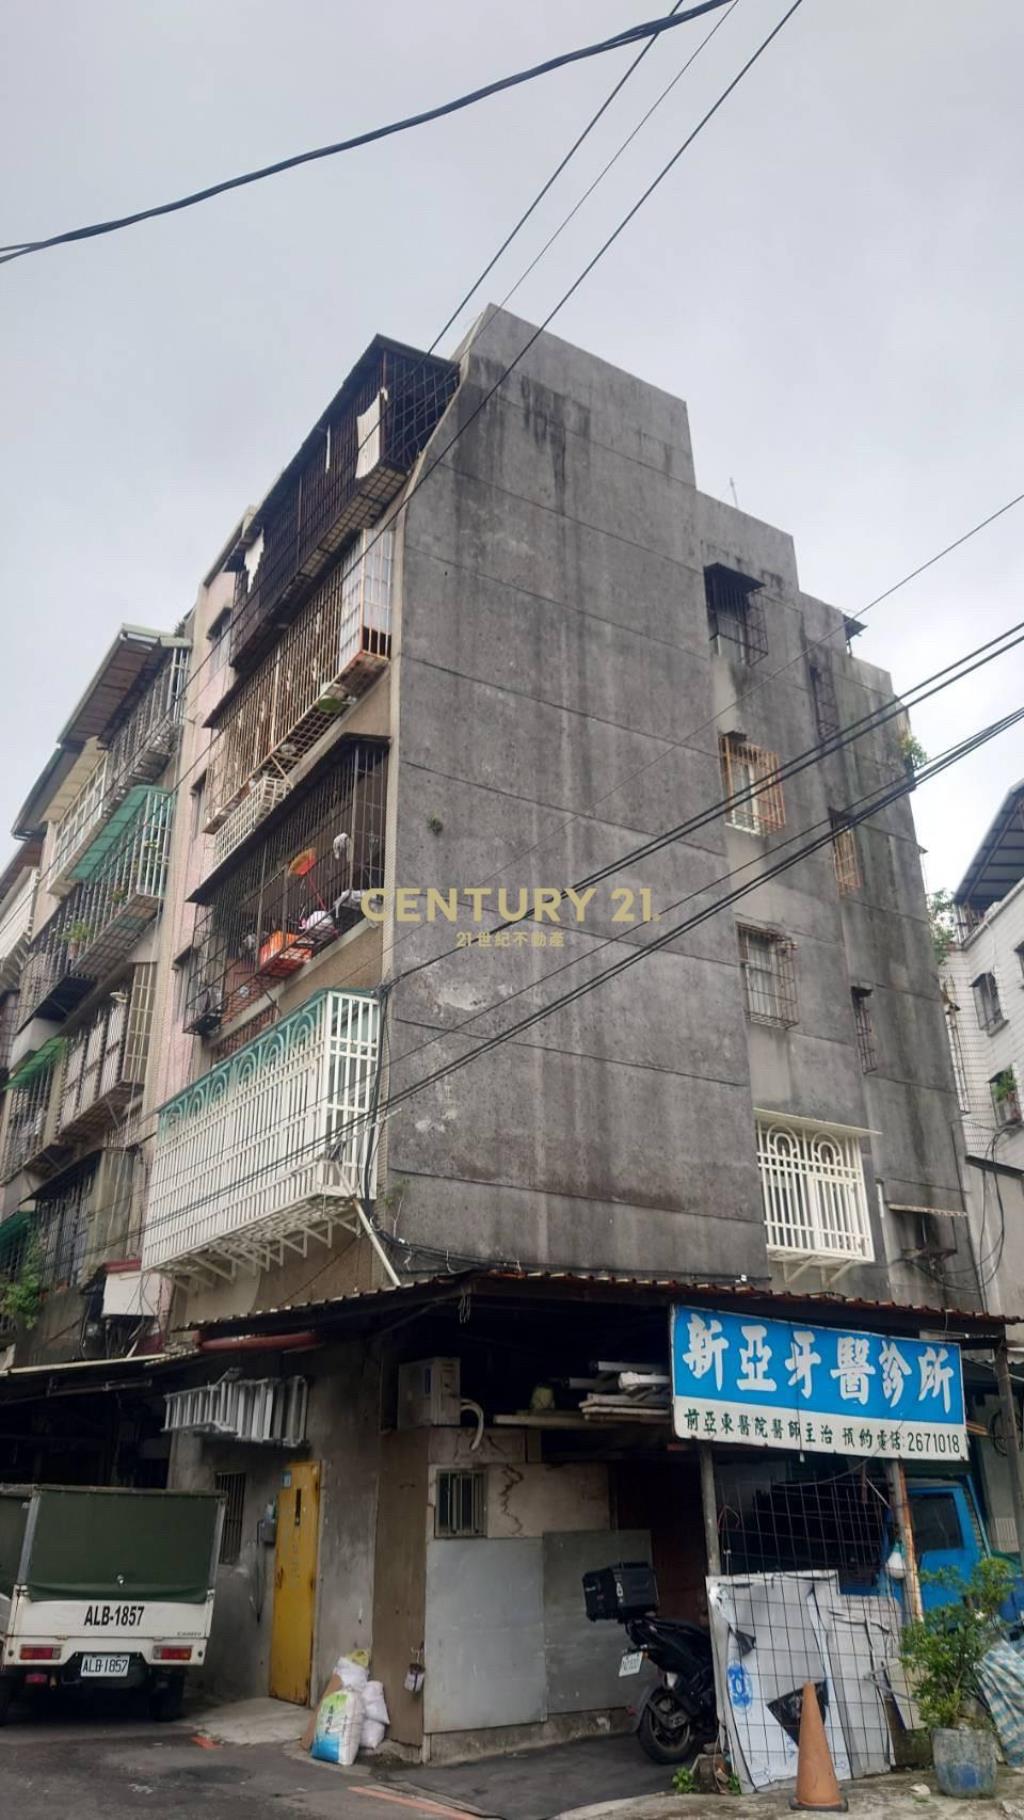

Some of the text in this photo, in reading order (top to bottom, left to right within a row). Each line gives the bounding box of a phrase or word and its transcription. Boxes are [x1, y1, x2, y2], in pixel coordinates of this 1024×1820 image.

[682, 1312, 954, 1413] 新亞牙醫診所
[684, 1408, 833, 1445] 前亞東醫院醫師主治
[84, 1605, 145, 1626] ALB-1857
[82, 1658, 129, 1673] ALB-1857
